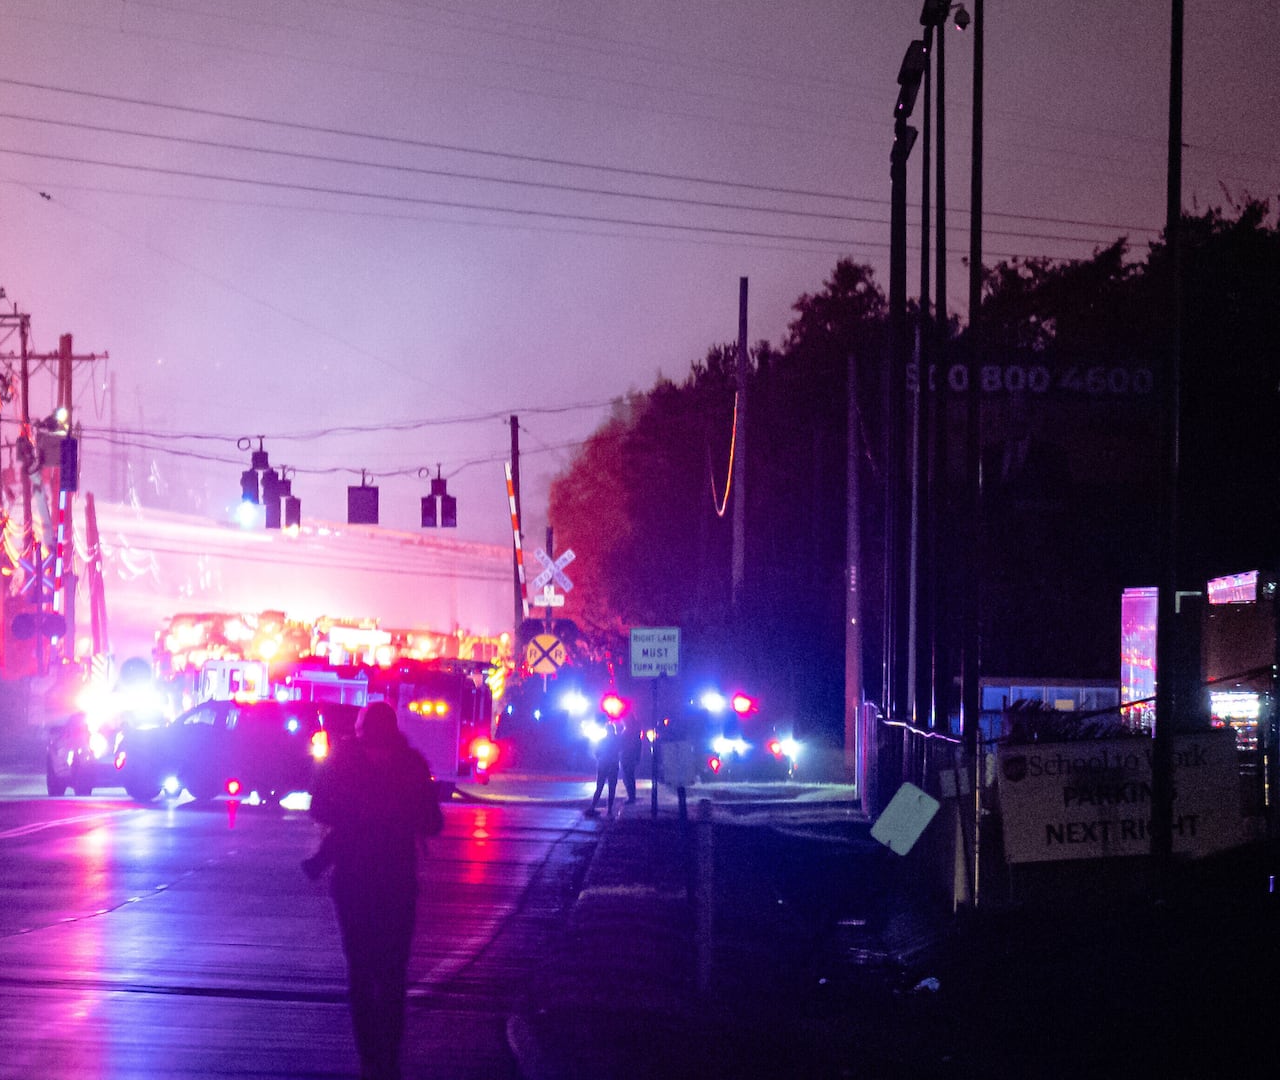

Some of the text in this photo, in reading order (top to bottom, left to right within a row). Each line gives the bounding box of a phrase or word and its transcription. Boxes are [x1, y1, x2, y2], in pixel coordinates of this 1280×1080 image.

[980, 364, 1050, 393] 800
[657, 634, 677, 642] LANE
[642, 647, 668, 658] MUST
[633, 663, 653, 672] TURN
[1029, 749, 1108, 777] School
[1116, 753, 1139, 772] to
[1062, 780, 1178, 808] PARKIN
[1046, 819, 1114, 846] NEXT
